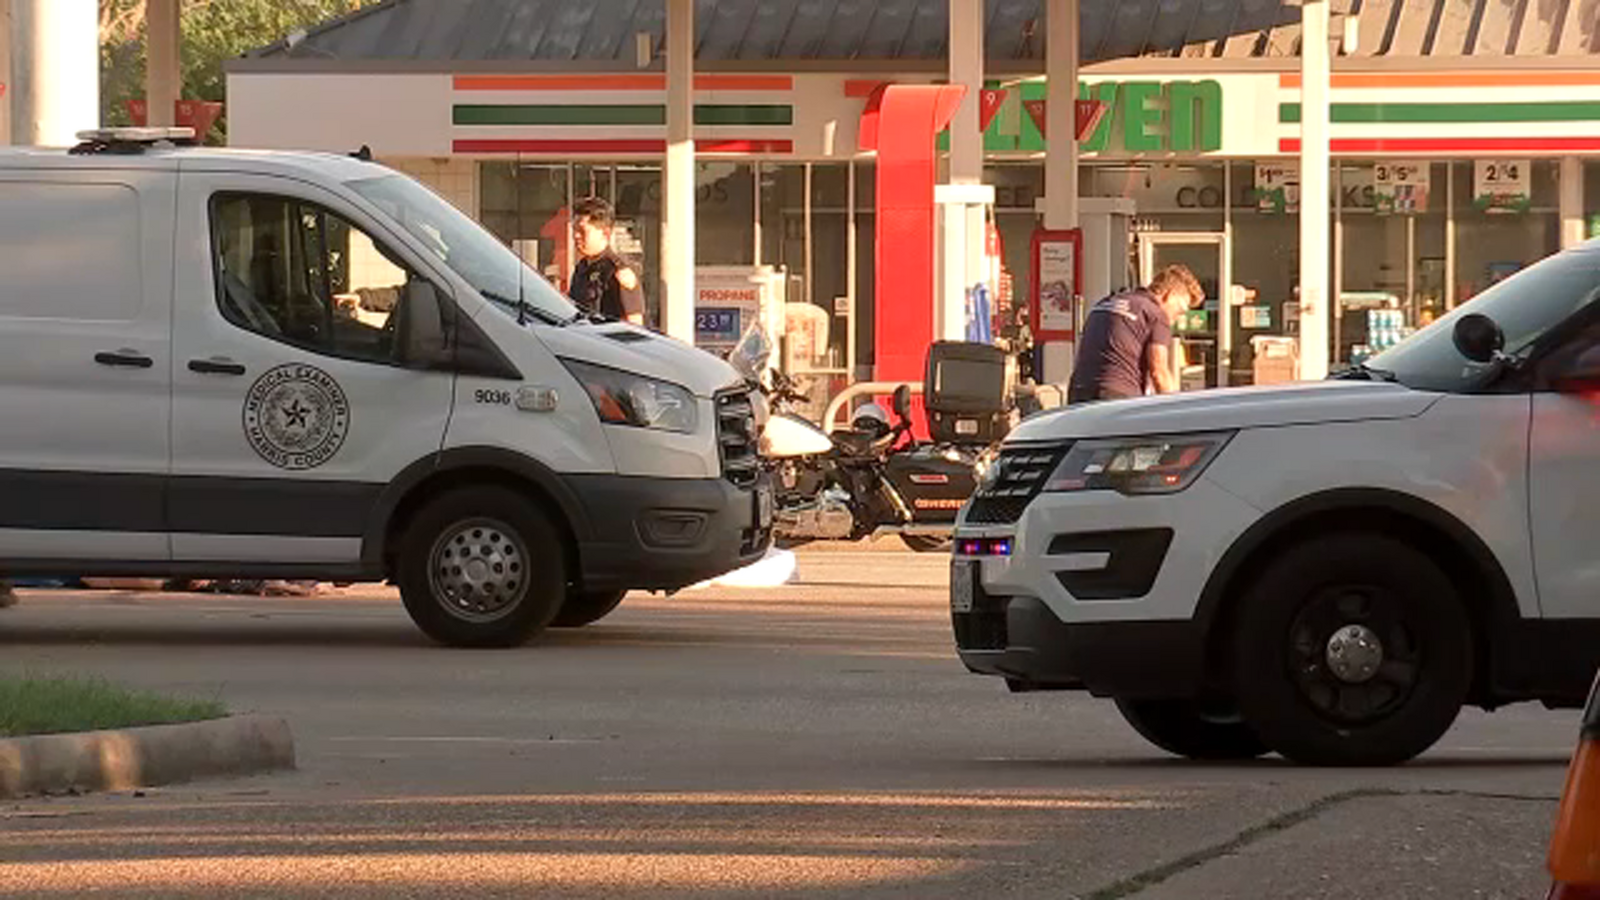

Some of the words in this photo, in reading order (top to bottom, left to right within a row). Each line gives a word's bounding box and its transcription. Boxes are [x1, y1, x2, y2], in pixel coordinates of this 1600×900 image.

[985, 91, 996, 106] 9
[700, 290, 756, 301] PROPANE
[249, 368, 291, 411] MEDICAL
[296, 367, 345, 416] EXAMINER
[474, 389, 511, 406] 9036
[251, 426, 288, 466] HARRIS
[294, 432, 340, 466] COUNTY
